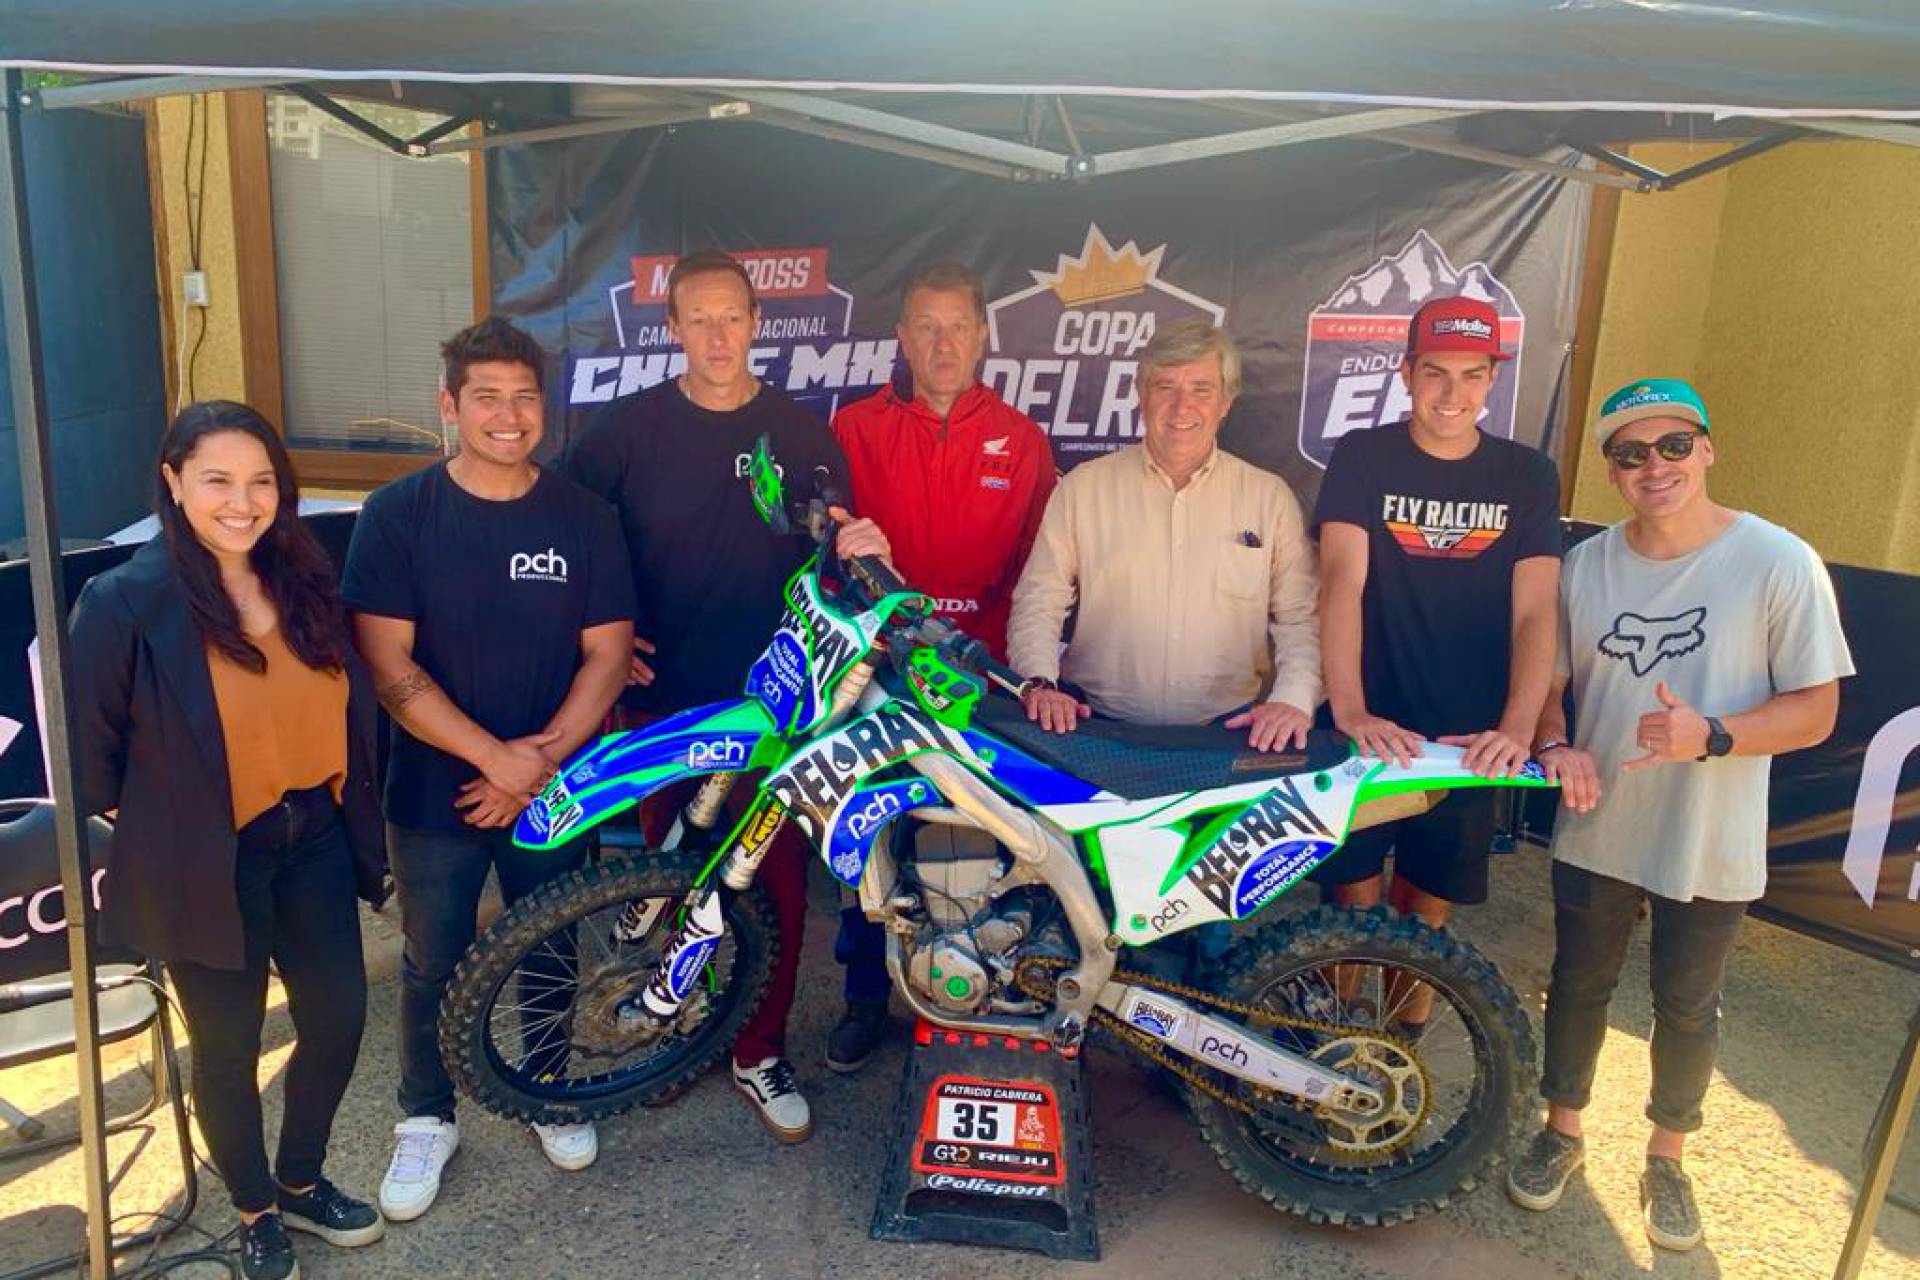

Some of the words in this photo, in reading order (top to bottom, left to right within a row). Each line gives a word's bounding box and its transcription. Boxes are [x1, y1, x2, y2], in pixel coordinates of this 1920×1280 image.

[650, 257, 811, 296] MROSS
[1053, 311, 1155, 356] COPA
[1341, 353, 1404, 375] ENDU
[1383, 495, 1423, 524] FLY
[1425, 501, 1509, 530] RACING
[509, 547, 567, 580] pch
[931, 598, 979, 613] NDA
[688, 735, 745, 769] pch
[848, 791, 900, 840] pch
[1253, 852, 1289, 881] TOTAL
[1150, 897, 1189, 933] pch
[1201, 1036, 1248, 1067] pch
[944, 1084, 990, 1097] PATRICIO
[993, 1089, 1043, 1102] CABRERA
[953, 1103, 998, 1141] 35
[979, 1152, 1048, 1166] RIEJU
[927, 1173, 1049, 1197] Polisport
